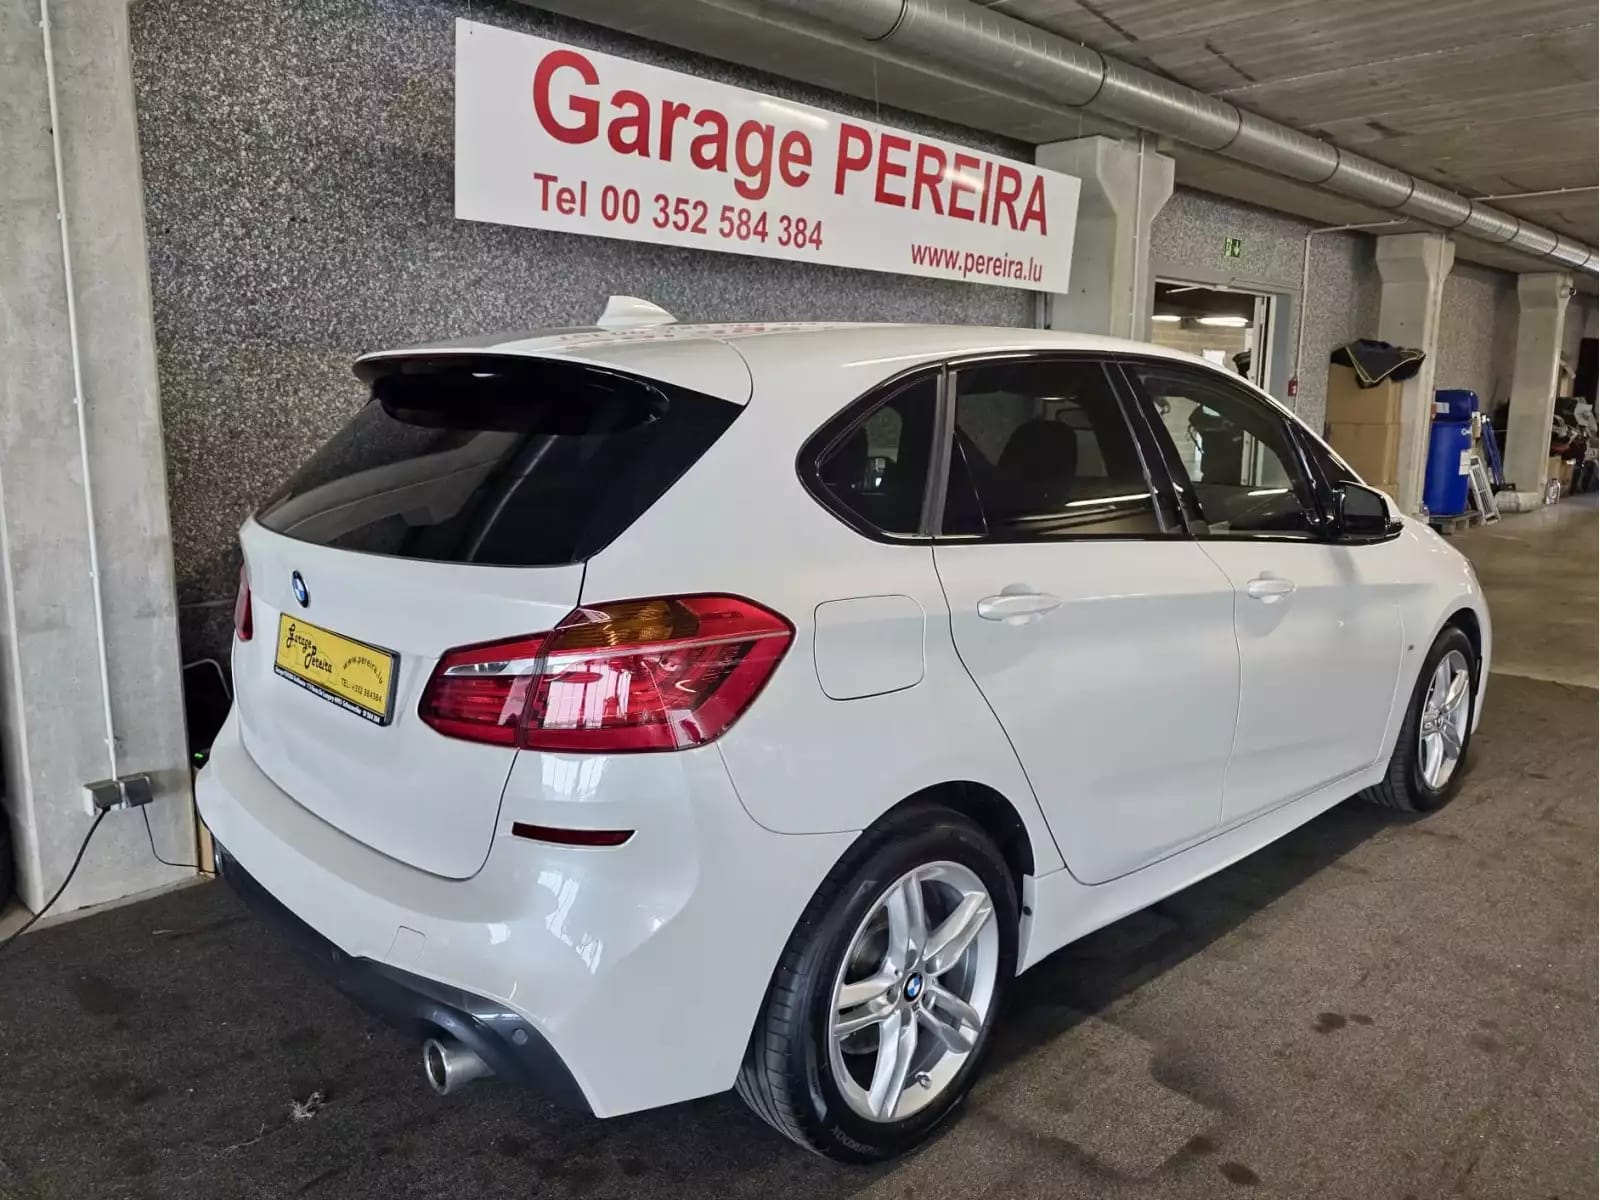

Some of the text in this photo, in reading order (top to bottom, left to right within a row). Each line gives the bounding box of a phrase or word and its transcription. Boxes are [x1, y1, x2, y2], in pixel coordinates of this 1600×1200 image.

[532, 48, 1048, 237] Garage PEREIRA
[533, 172, 823, 251] Tel 00 352 584 384
[911, 243, 1044, 284] www.pereira.lu
[286, 623, 313, 653] Garage
[304, 645, 333, 674] Pereira
